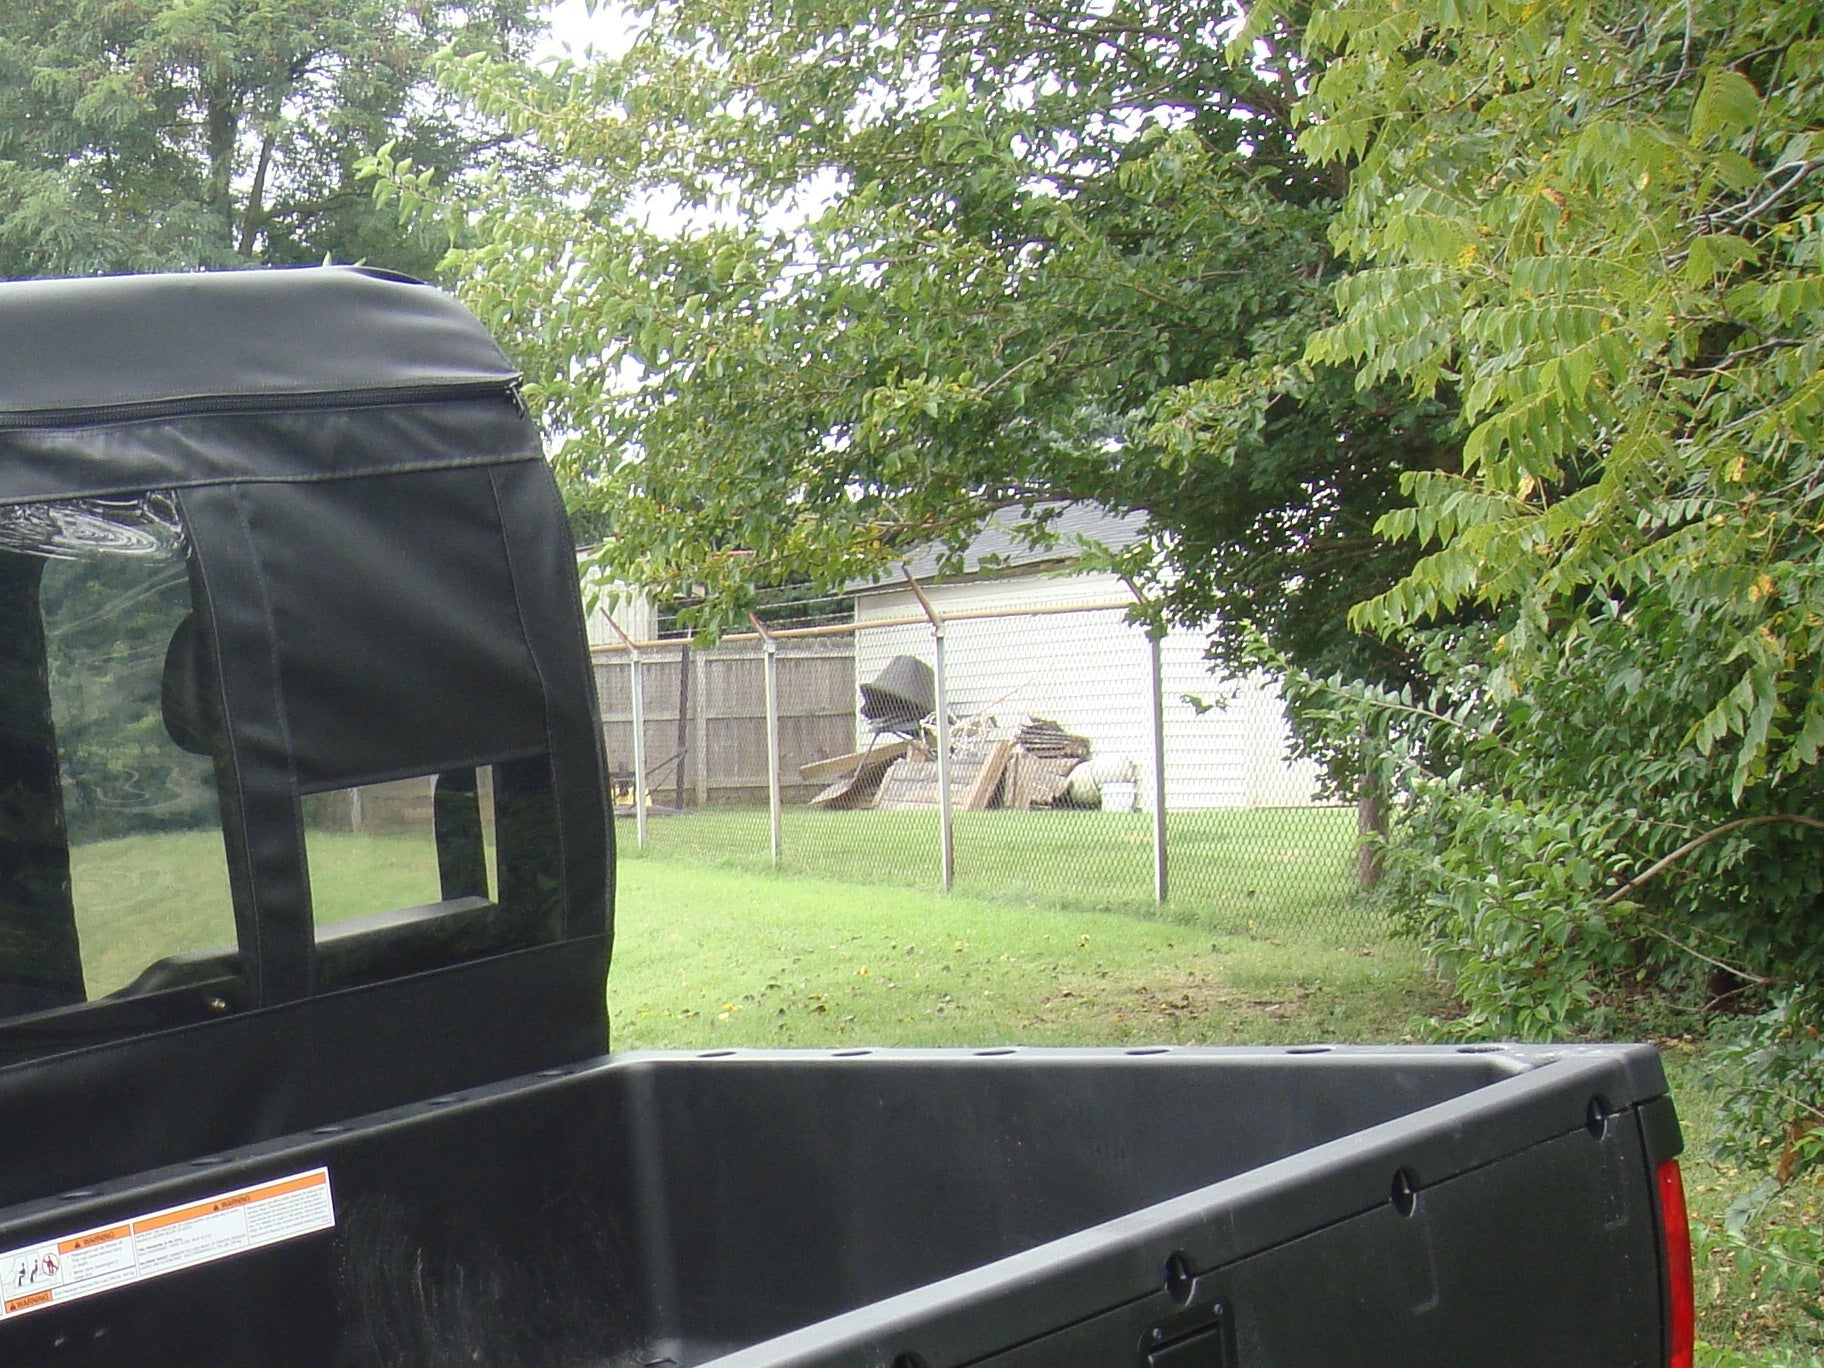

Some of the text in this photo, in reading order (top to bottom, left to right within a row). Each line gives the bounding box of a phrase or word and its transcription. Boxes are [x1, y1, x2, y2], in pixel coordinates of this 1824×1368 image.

[221, 1194, 251, 1209] WARNING
[83, 1231, 116, 1246] WARNING
[16, 1293, 50, 1309] WARNING
